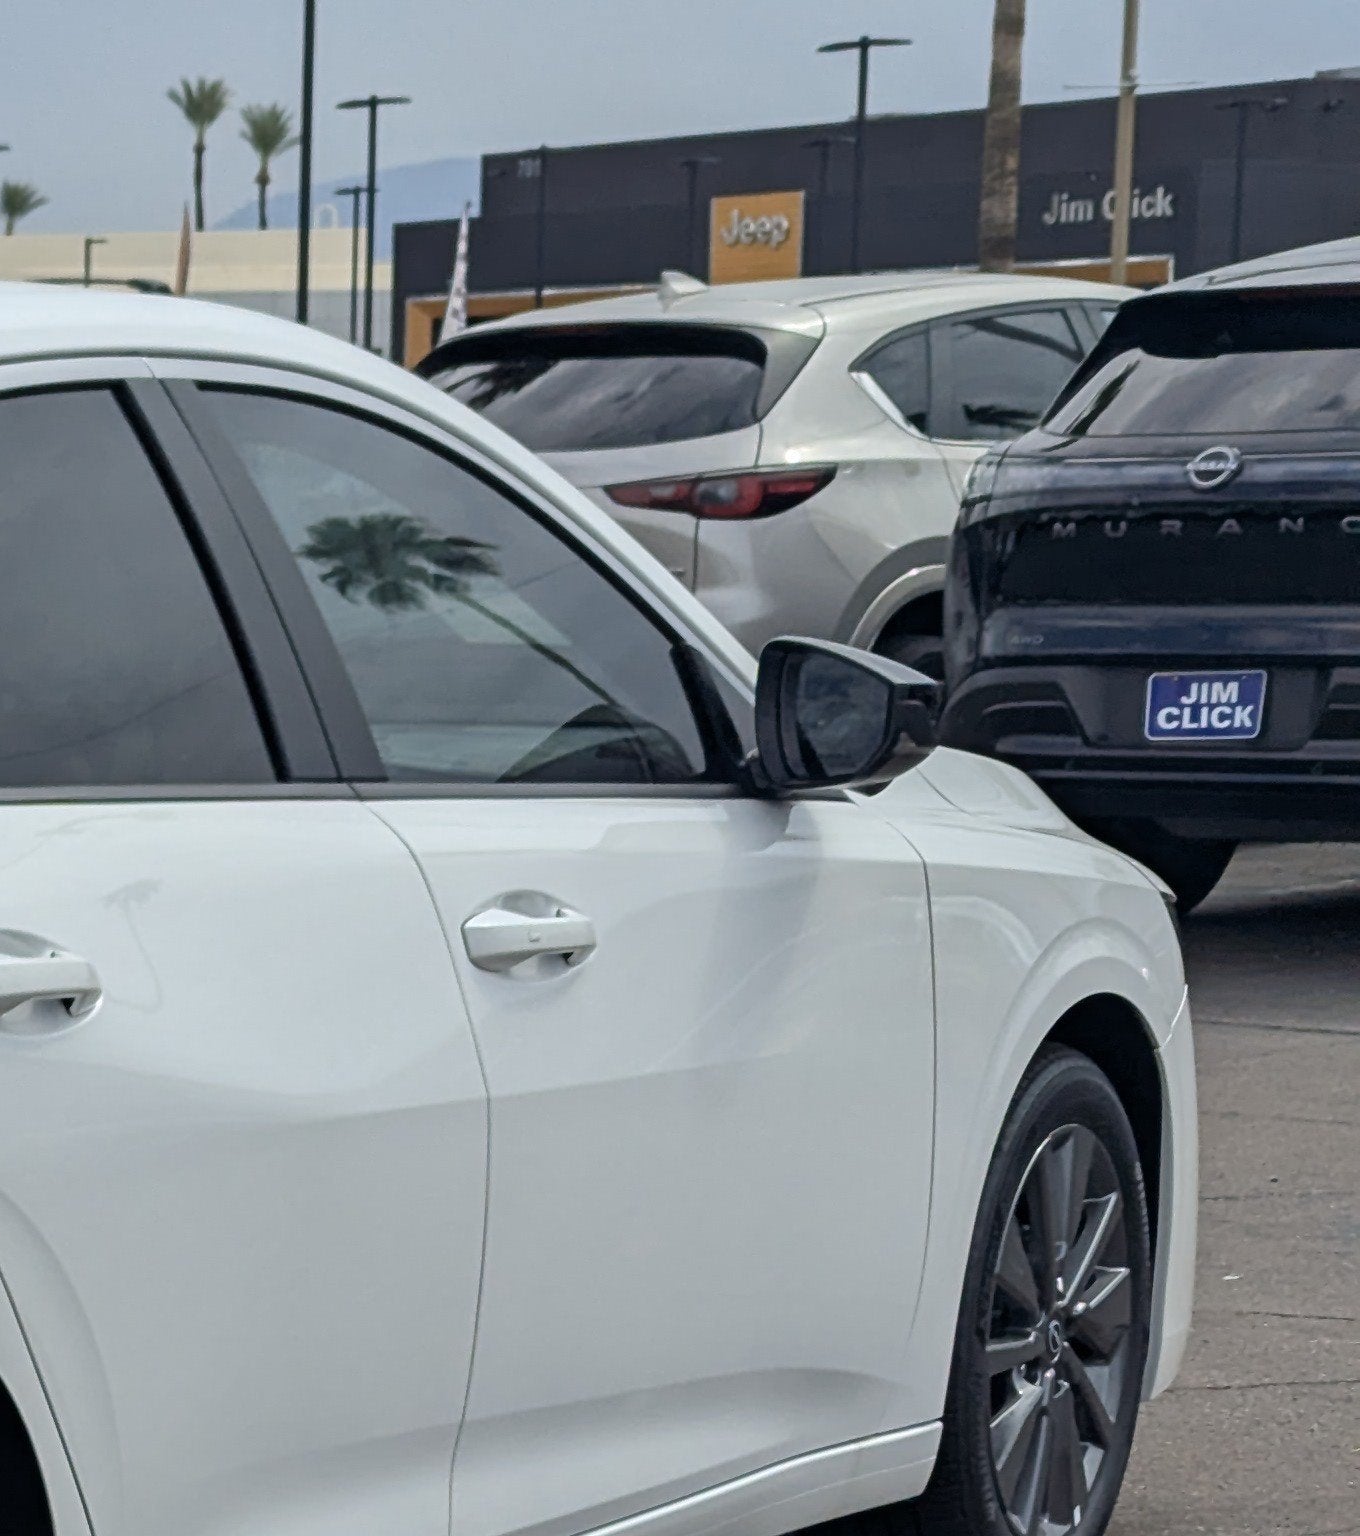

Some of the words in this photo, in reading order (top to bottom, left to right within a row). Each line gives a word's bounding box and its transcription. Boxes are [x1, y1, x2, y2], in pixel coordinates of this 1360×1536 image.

[1042, 191, 1094, 224] Jim
[1101, 185, 1175, 220] Cick
[720, 208, 789, 250] Jeep
[1180, 681, 1239, 705] JIM
[1156, 704, 1254, 730] CLICK
